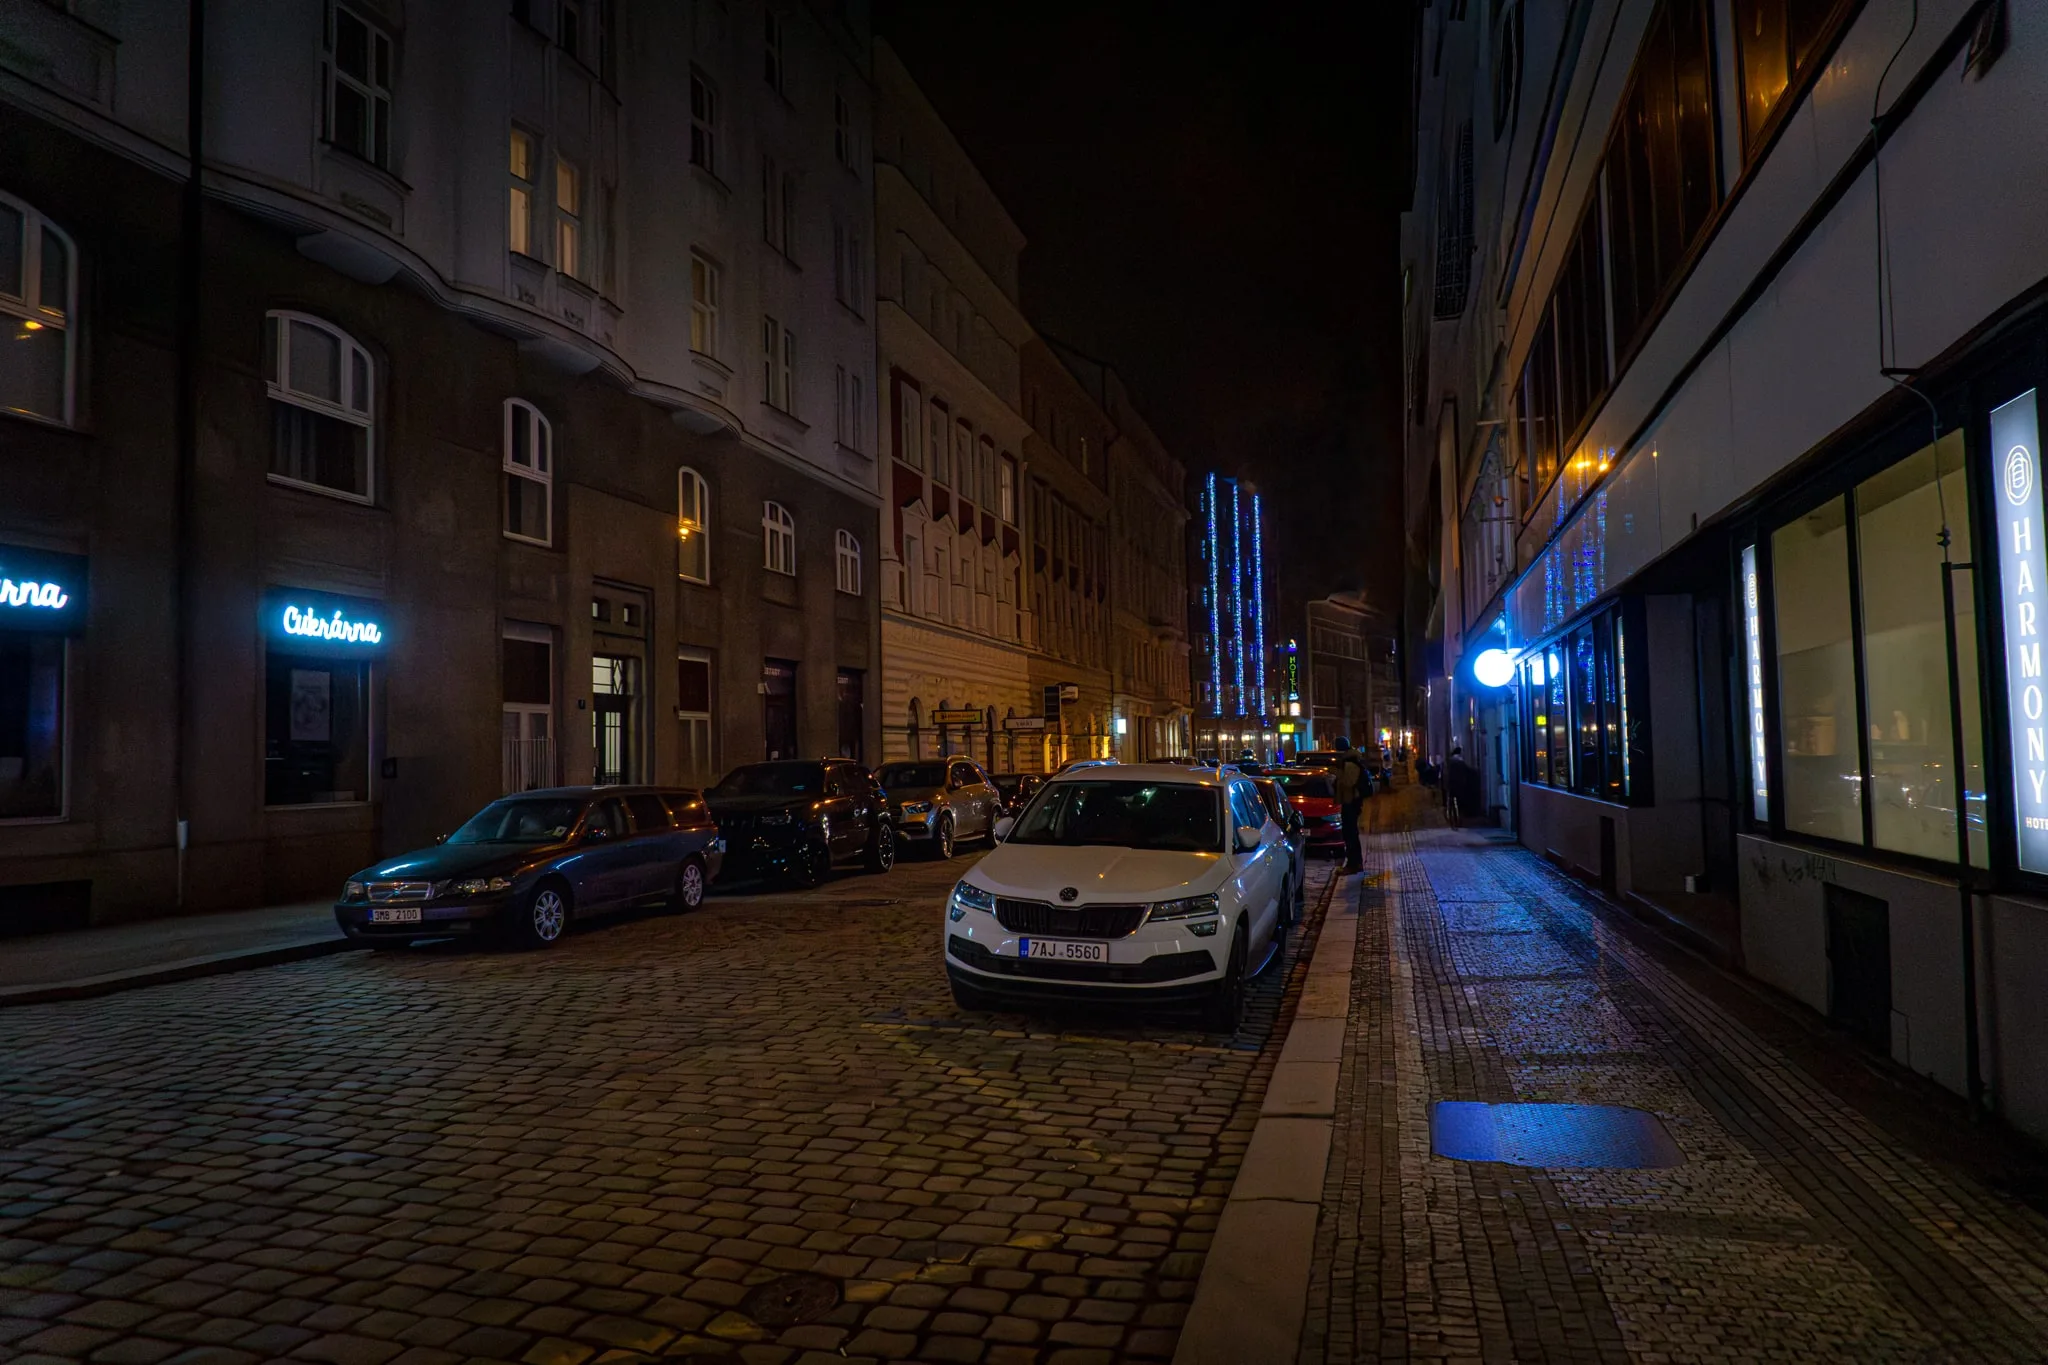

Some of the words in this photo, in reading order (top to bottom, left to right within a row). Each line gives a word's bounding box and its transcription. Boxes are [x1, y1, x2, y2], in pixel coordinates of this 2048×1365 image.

[0, 578, 68, 609] rna
[283, 605, 381, 643] Cukrárna
[1288, 656, 1298, 693] HOTEL
[2012, 517, 2046, 804] HARMONY
[1031, 941, 1056, 957] 7AJ
[1066, 943, 1101, 960] 5560
